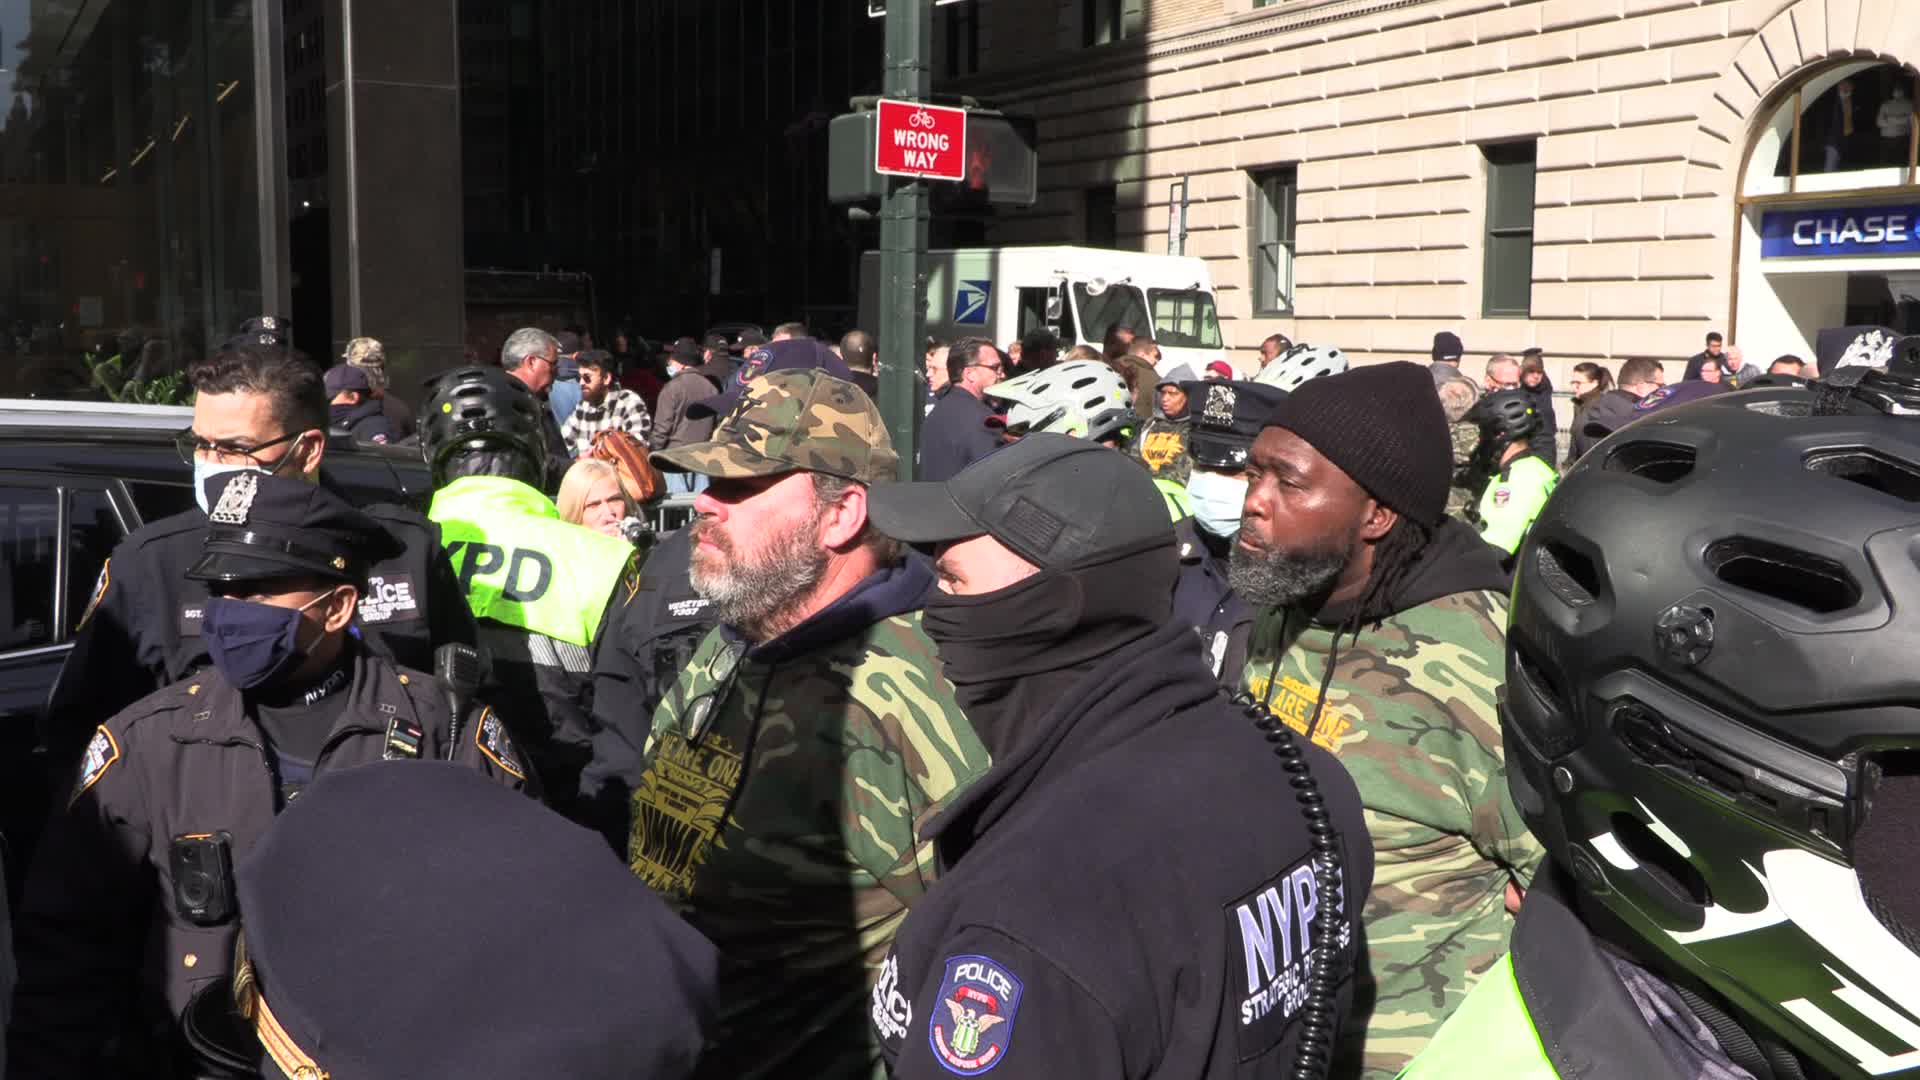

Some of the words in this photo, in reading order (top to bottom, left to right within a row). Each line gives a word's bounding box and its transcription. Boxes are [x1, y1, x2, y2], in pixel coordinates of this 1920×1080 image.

[893, 128, 949, 152] WRONG
[903, 149, 938, 169] WAY
[1793, 216, 1908, 246] CHASE
[1272, 687, 1309, 723] ARE
[953, 962, 1013, 1001] POLICE
